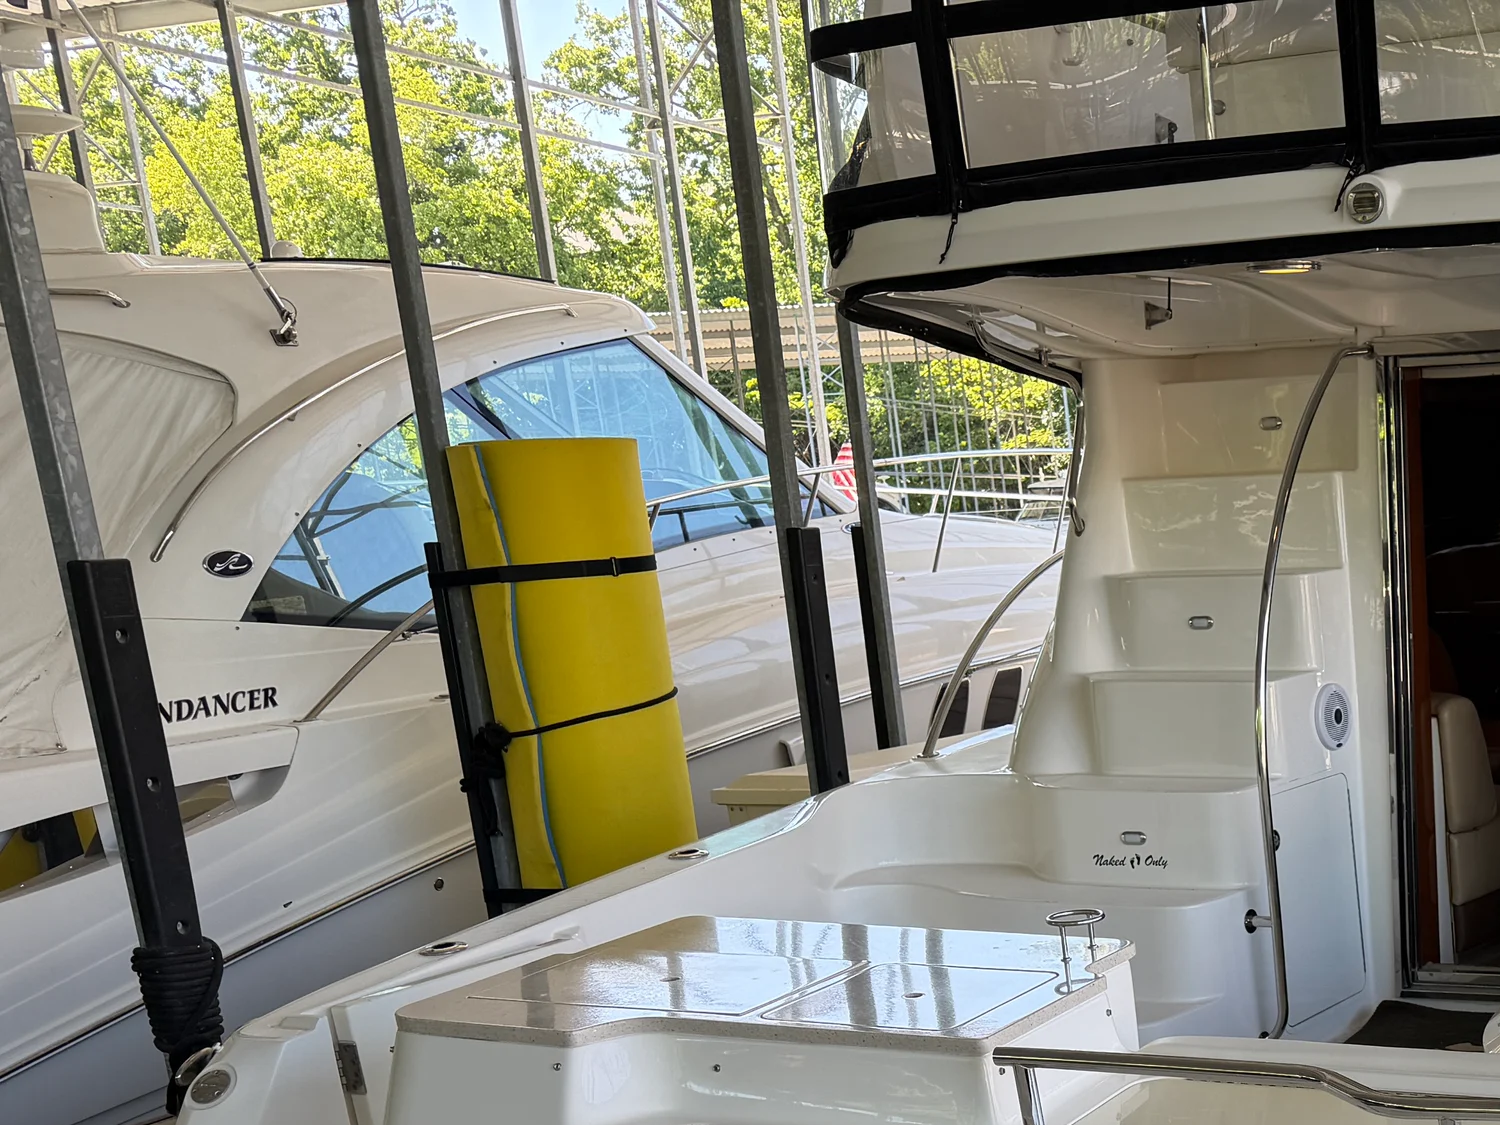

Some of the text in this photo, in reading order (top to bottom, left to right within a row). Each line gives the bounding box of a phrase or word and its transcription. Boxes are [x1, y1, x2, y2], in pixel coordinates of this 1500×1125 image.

[158, 687, 279, 724] NDANCER
[1092, 854, 1169, 870] Naked Only
